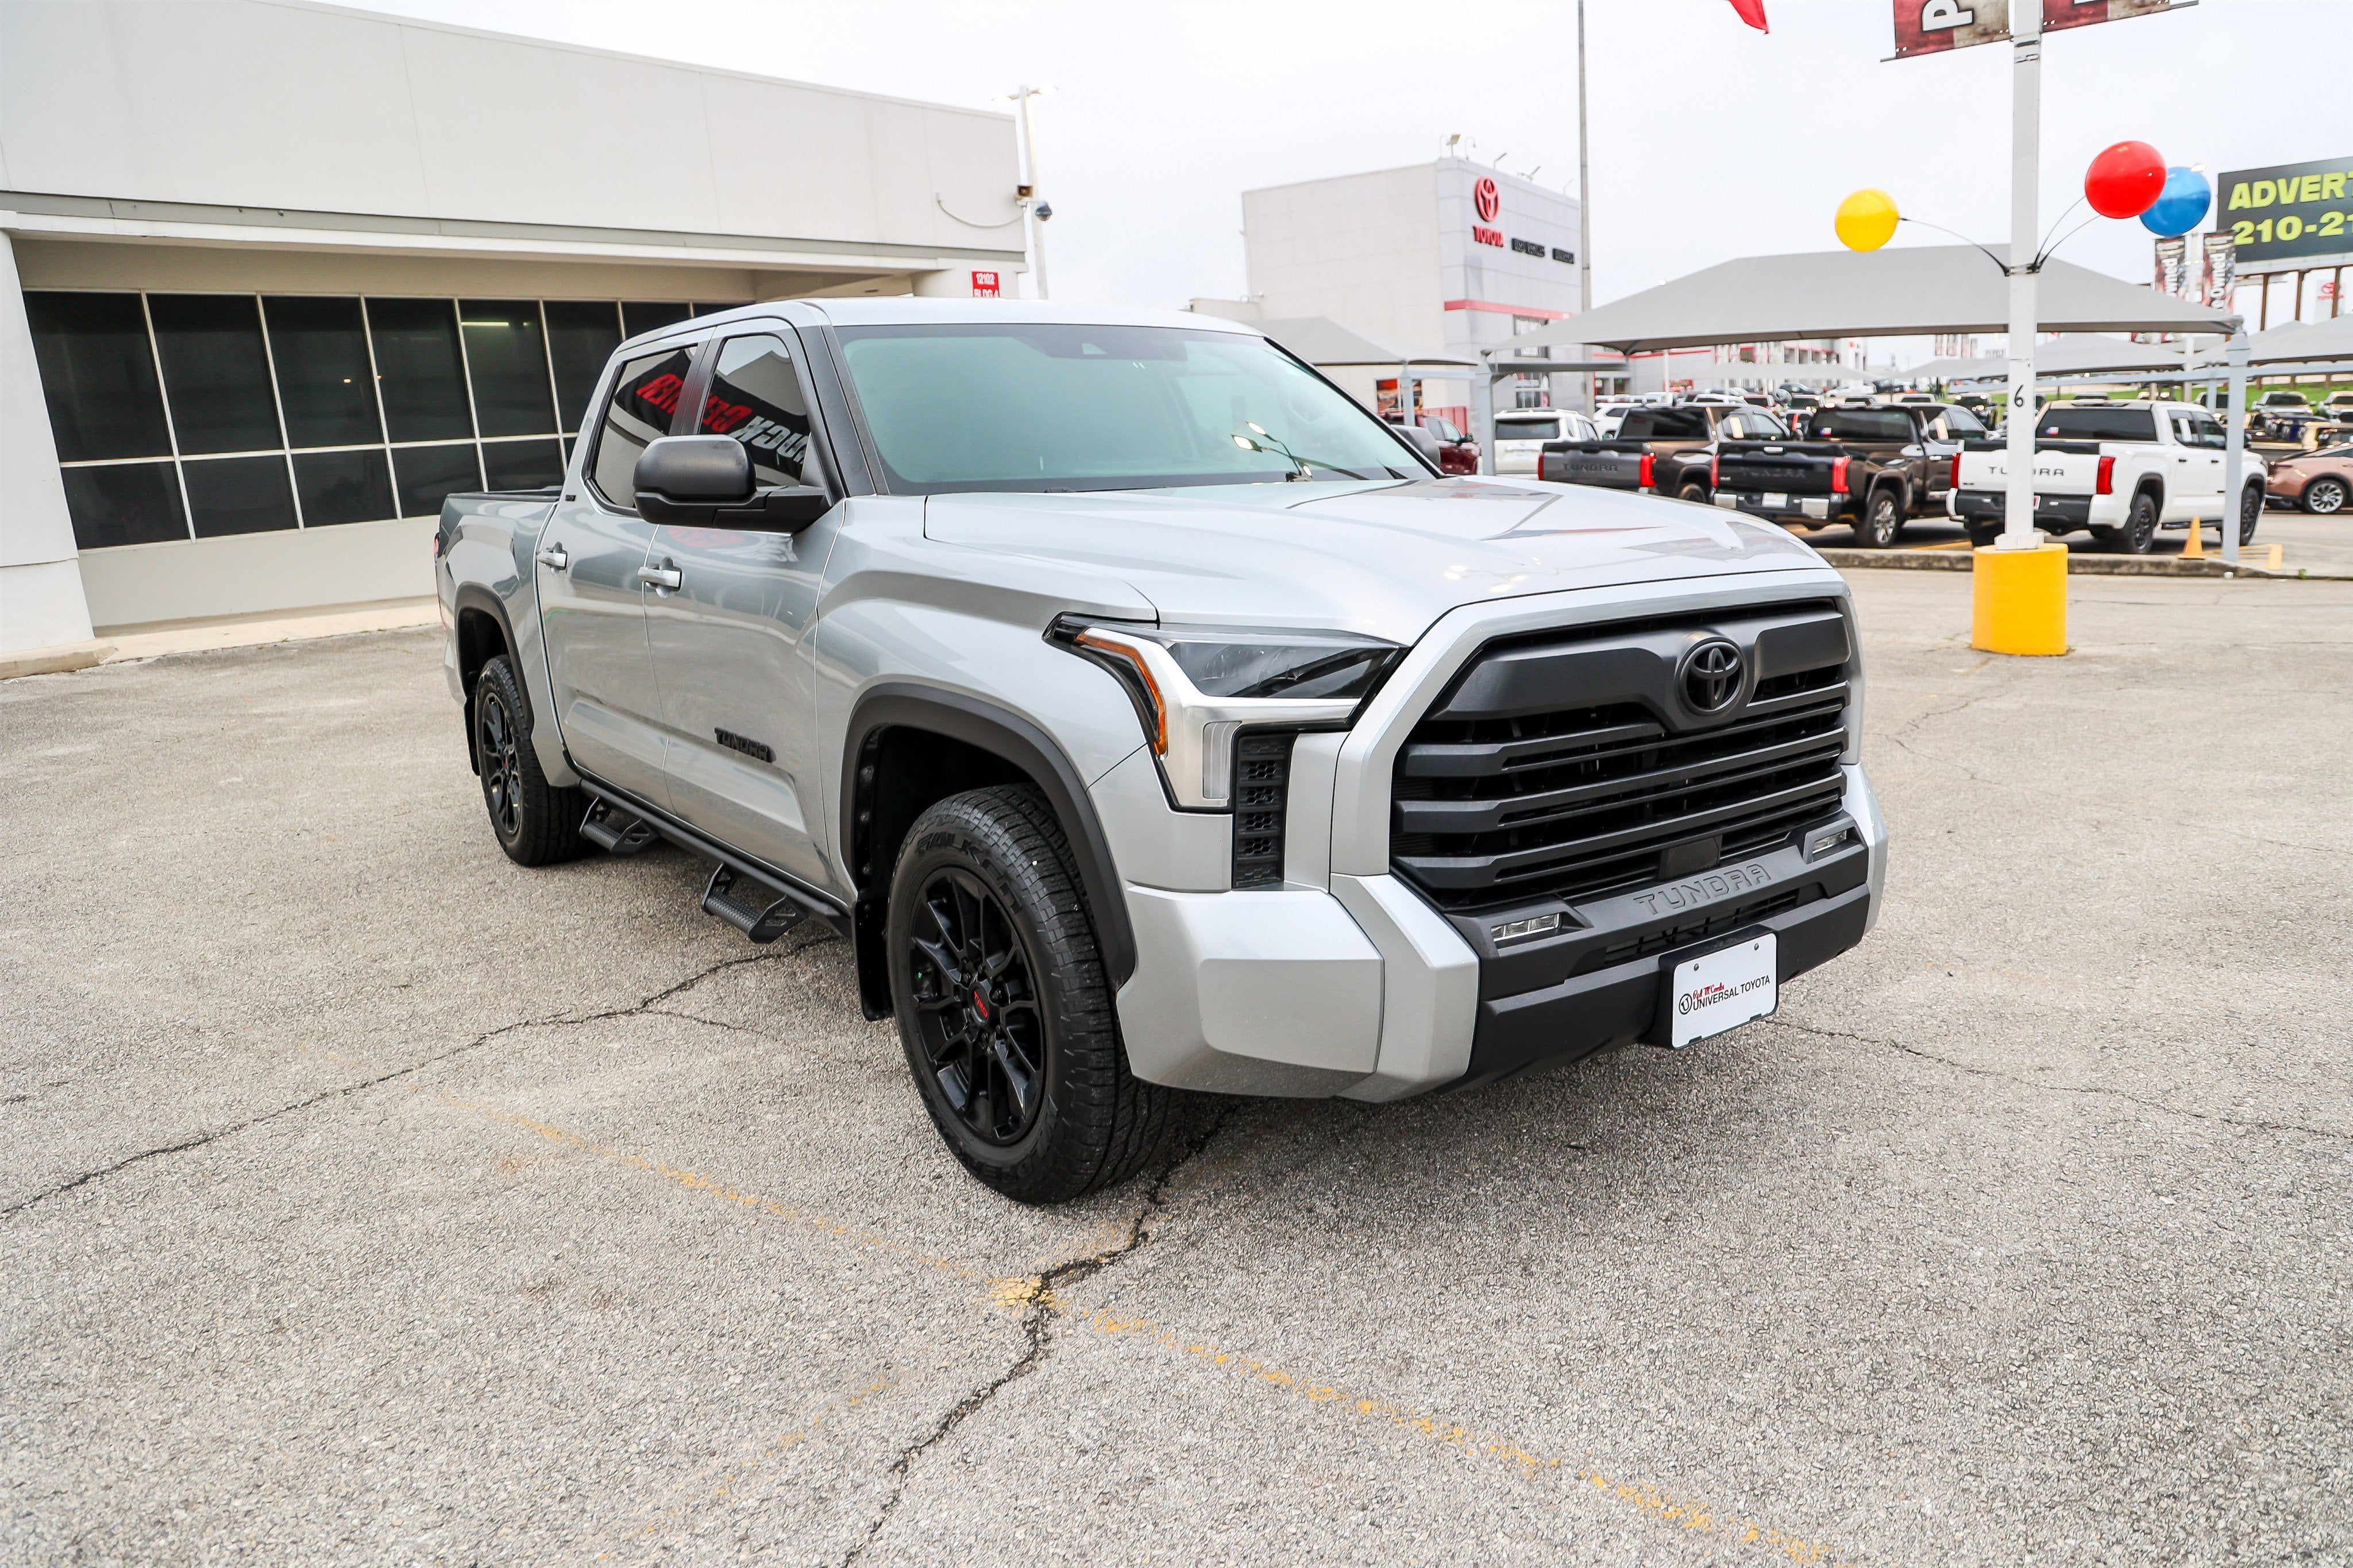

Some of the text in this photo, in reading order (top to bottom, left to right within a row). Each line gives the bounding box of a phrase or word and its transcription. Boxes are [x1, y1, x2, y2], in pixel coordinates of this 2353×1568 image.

[2227, 170, 2353, 211] ADVER
[1473, 225, 1505, 248] TOYOTA
[2013, 384, 2024, 408] 6
[1563, 463, 1618, 472] TUNDRA
[1988, 466, 2064, 476] TURA
[714, 727, 776, 764] TUNDRA
[1633, 863, 1772, 915] TUNDRA
[974, 990, 988, 1018] TRD
[1693, 975, 1770, 1011] UNIVERSAL TOYOTA
